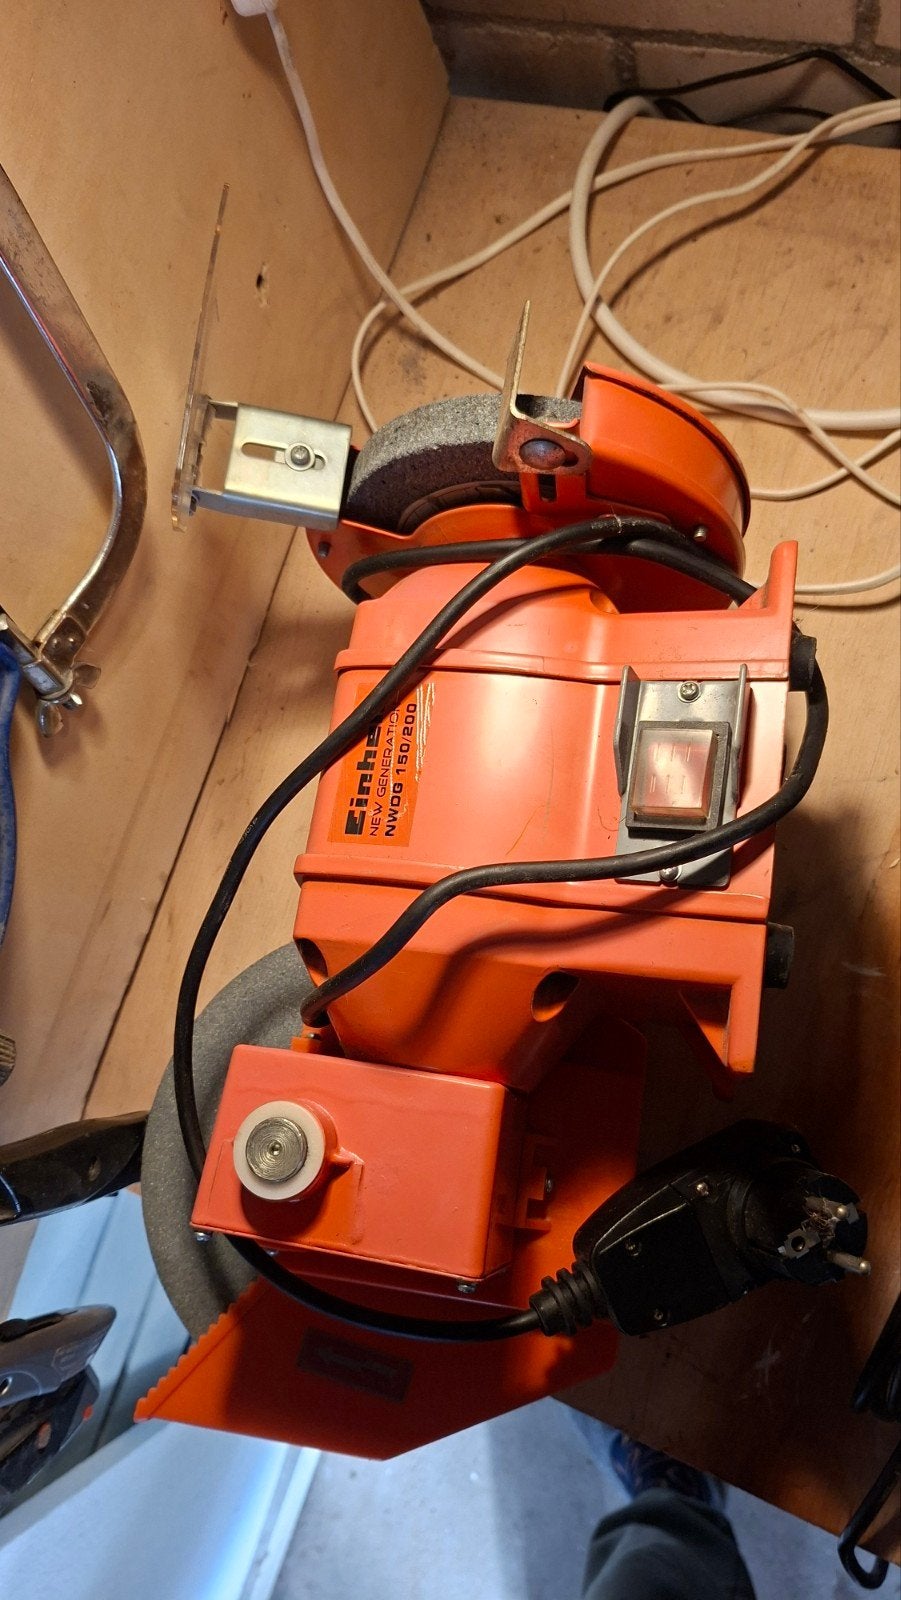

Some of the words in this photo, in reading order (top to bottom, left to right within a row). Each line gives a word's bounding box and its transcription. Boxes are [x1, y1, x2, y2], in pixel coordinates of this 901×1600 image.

[370, 802, 382, 836] NEW
[377, 709, 400, 797] GENERATIO
[385, 783, 403, 836] NWDG
[396, 703, 417, 775] 150/200
